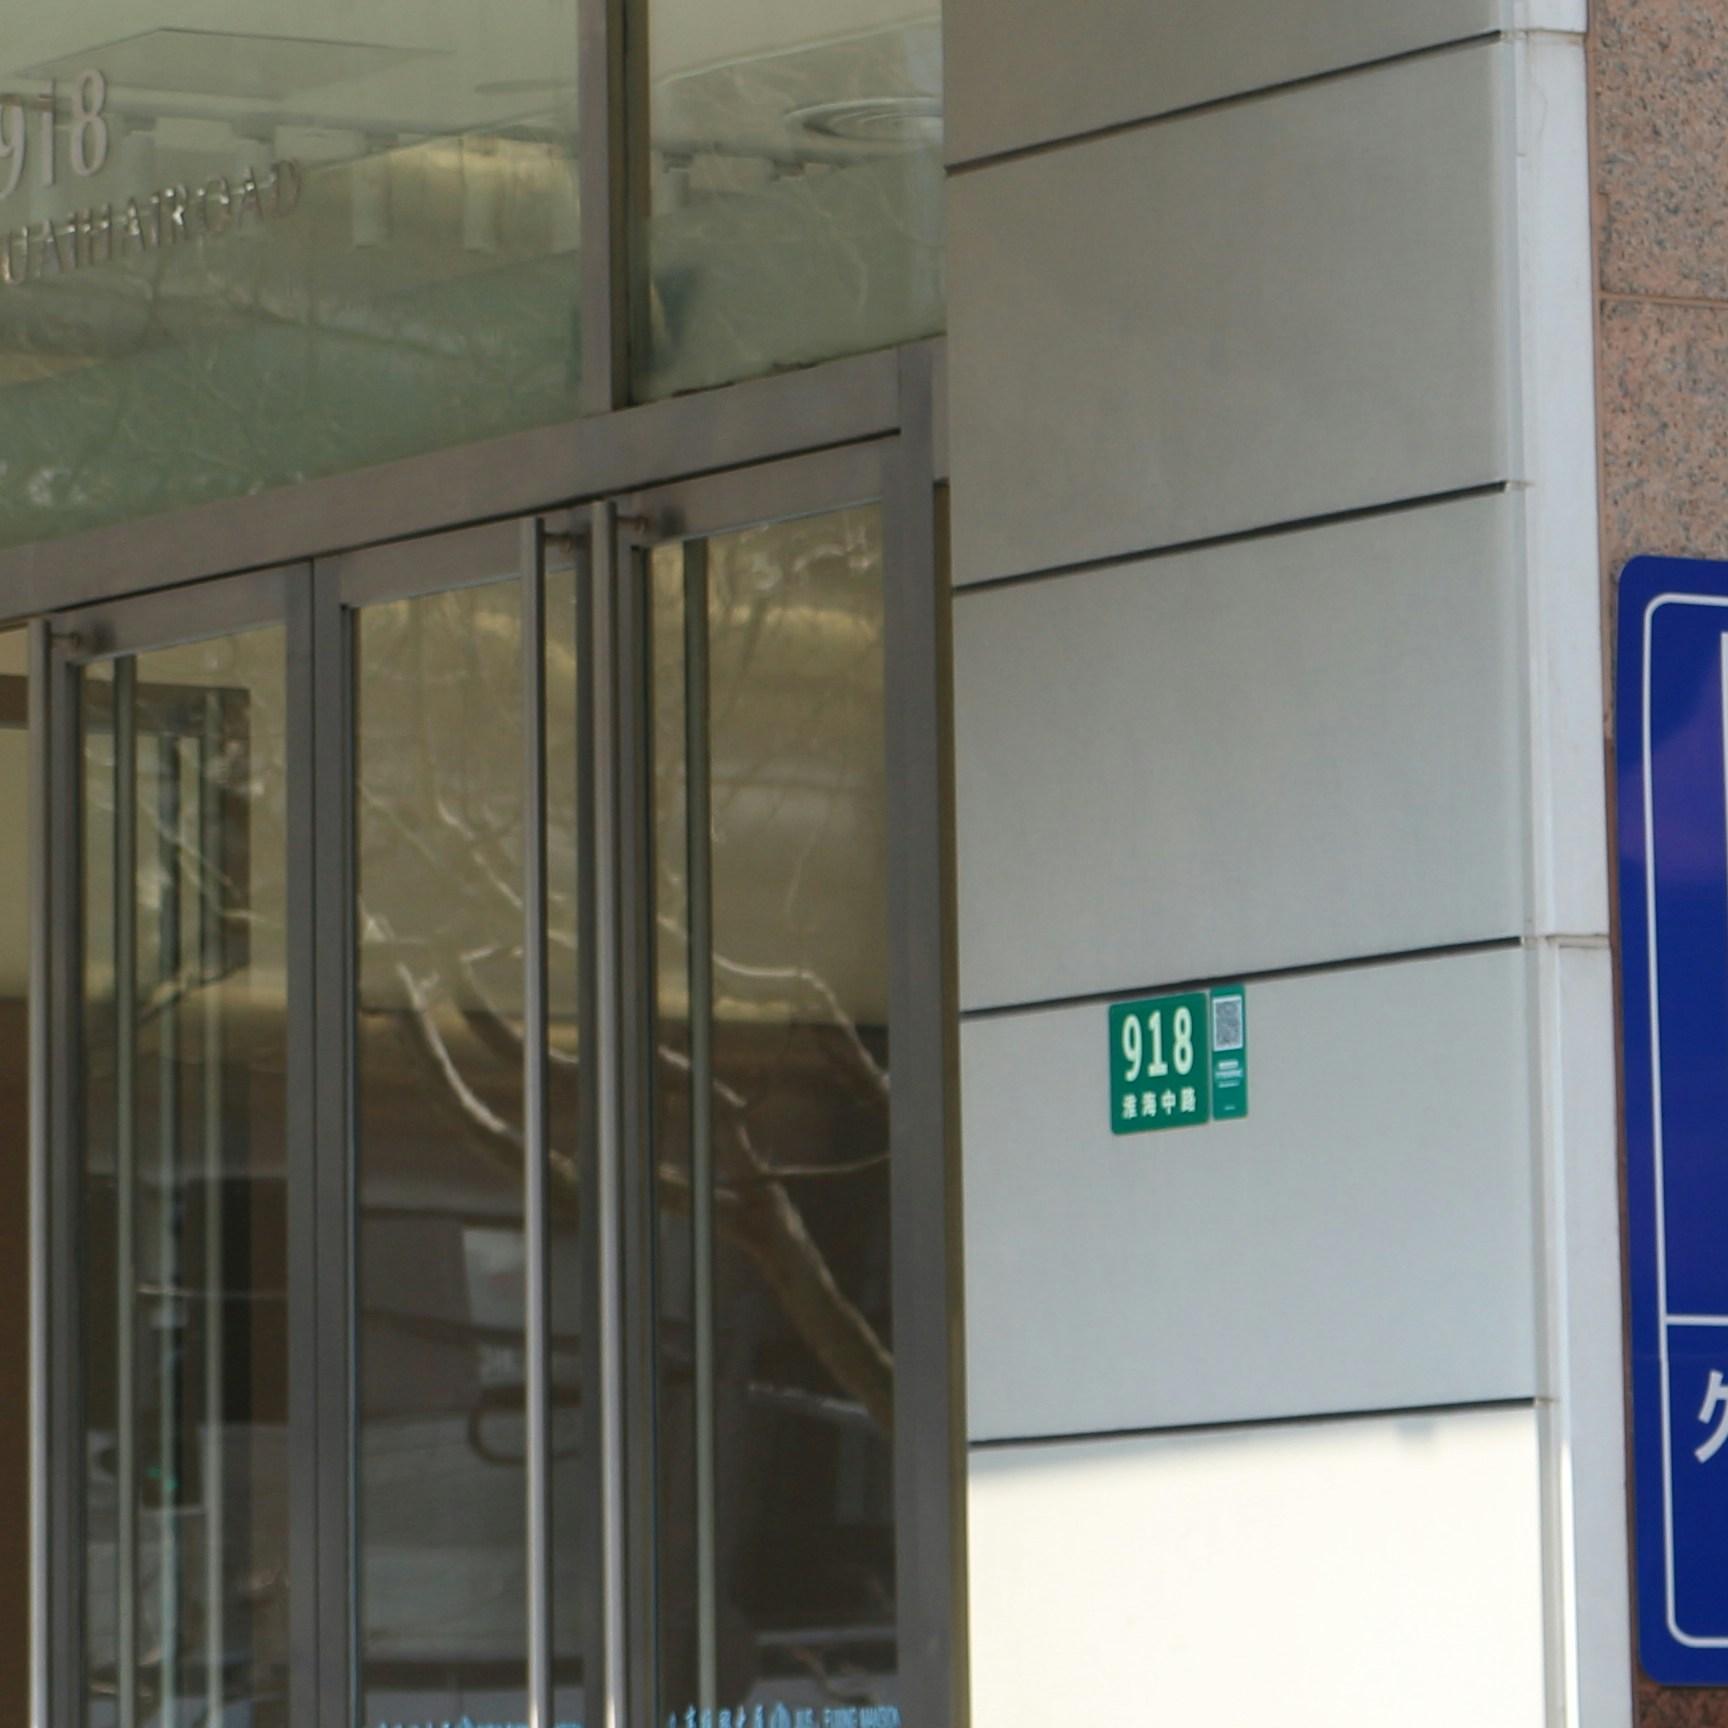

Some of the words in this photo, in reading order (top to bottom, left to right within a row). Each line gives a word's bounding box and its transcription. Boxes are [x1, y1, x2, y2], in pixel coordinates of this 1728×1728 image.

[1122, 1006, 1193, 1082] 918
[1121, 1086, 1196, 1120] 淮海中路
